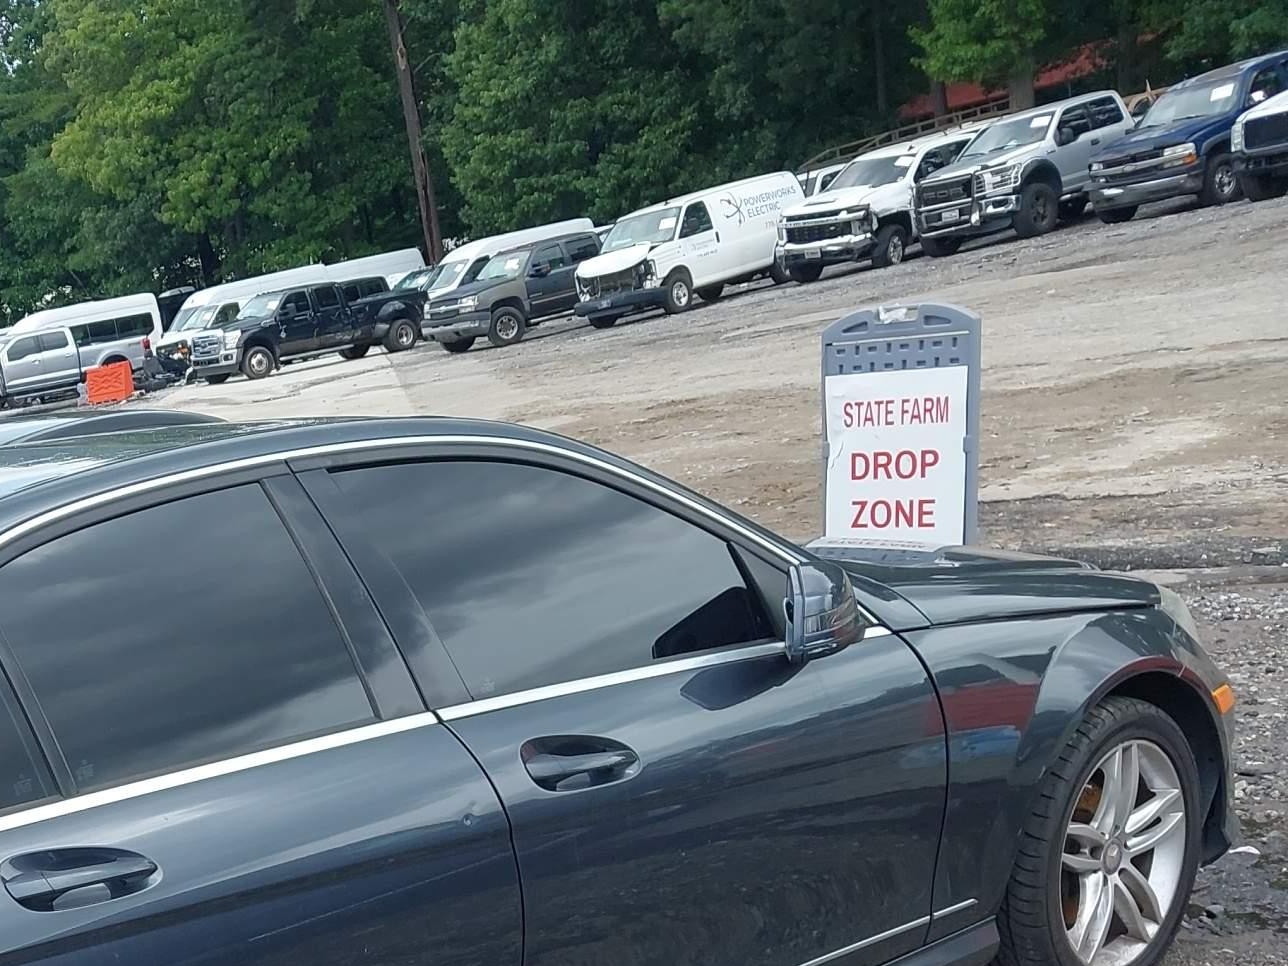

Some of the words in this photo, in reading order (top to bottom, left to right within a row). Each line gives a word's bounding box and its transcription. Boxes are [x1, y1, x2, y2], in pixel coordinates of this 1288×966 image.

[744, 186, 796, 206] POWERWORKS
[747, 201, 781, 218] ELECTRIC
[843, 399, 895, 428] STATE
[900, 395, 950, 425] FARM
[850, 449, 940, 481] DROP
[850, 499, 936, 529] ZONE
